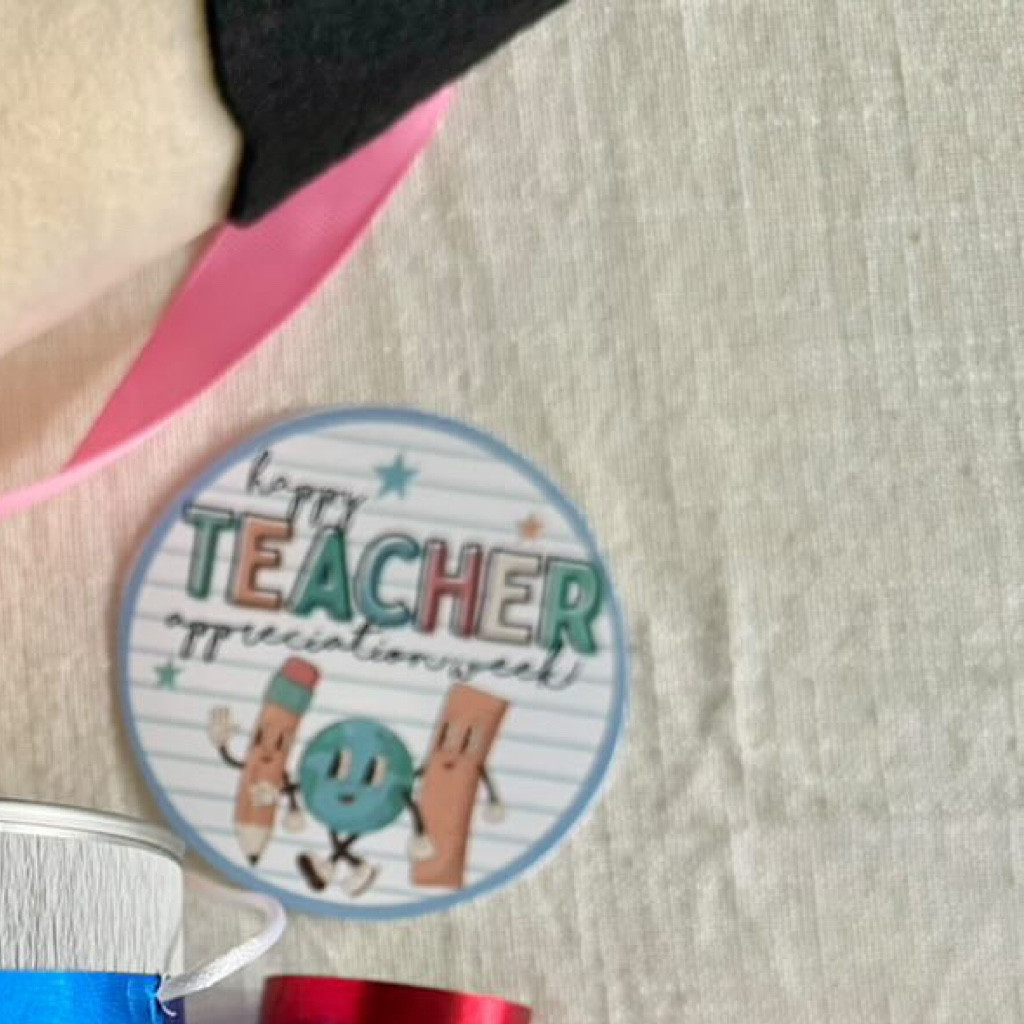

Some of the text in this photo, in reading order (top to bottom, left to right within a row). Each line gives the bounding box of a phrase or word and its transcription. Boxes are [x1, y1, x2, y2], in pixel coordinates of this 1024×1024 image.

[246, 449, 368, 528] happy
[183, 503, 607, 657] TEACHER
[164, 611, 584, 690] appreciation week
